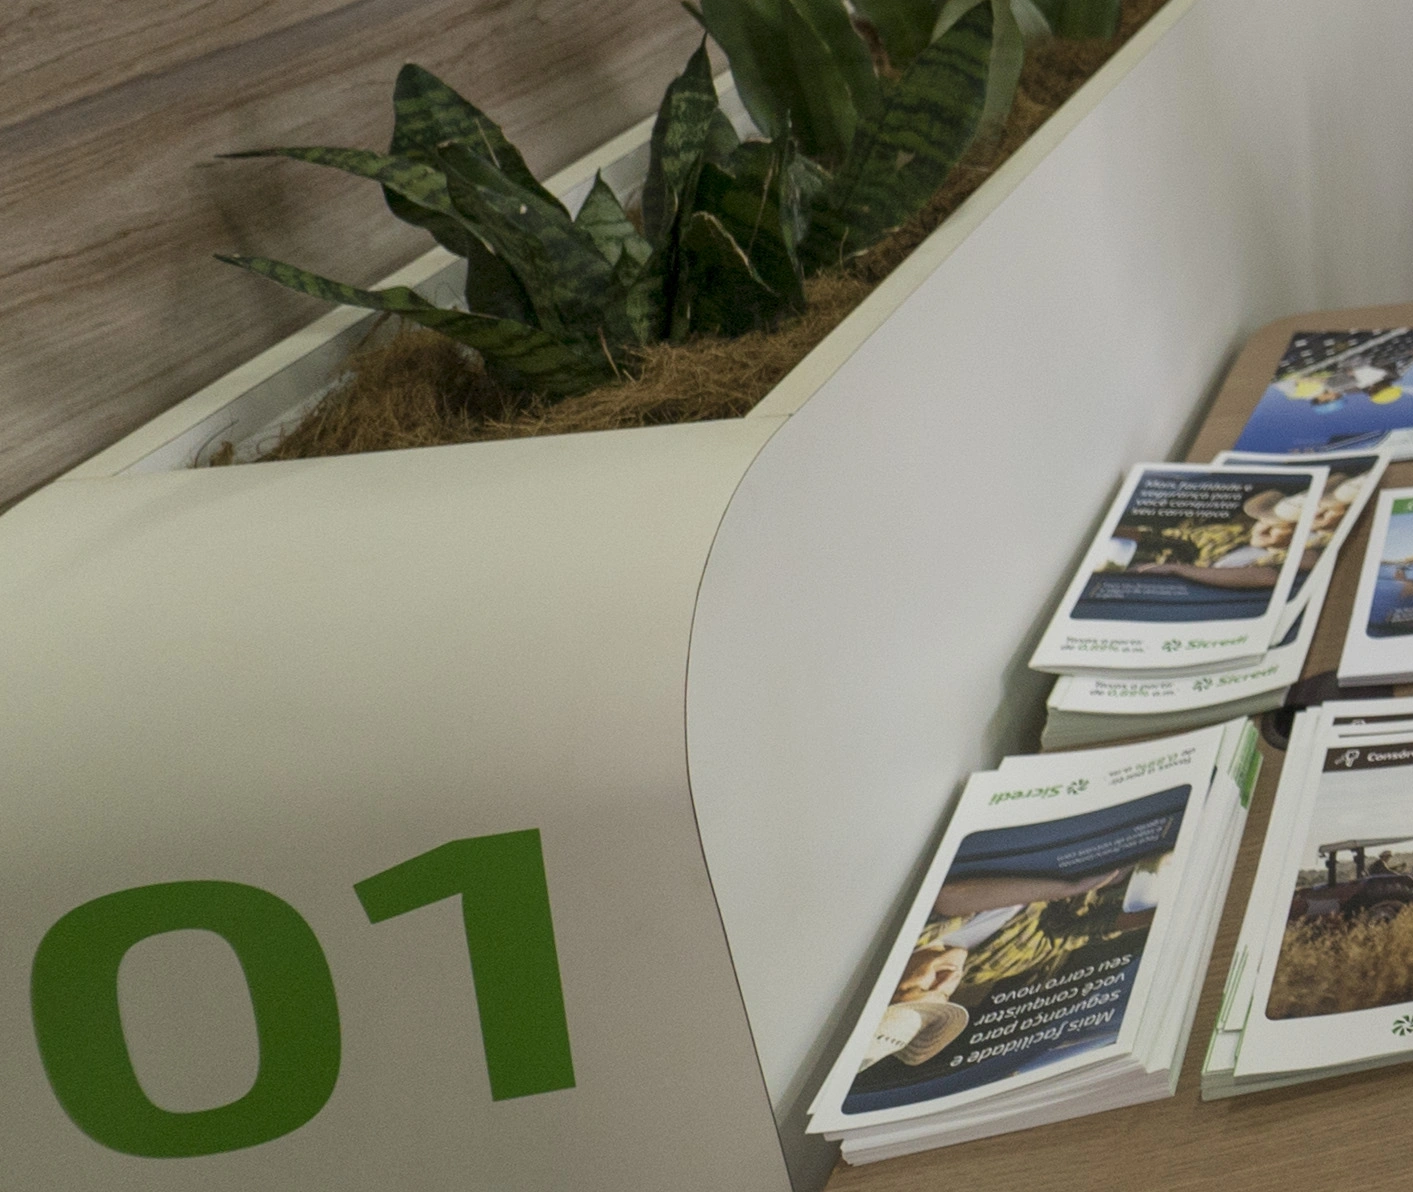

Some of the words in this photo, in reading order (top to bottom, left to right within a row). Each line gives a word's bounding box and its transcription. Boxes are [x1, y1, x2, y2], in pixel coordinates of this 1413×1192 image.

[988, 784, 1063, 806] Sicredi
[1098, 953, 1133, 973] seu
[1045, 966, 1094, 990] carro
[1081, 972, 1125, 997] você
[29, 828, 577, 1160] 01
[991, 983, 1042, 1004] novo.
[973, 986, 1078, 1027] conquistar
[1020, 990, 1122, 1030] segurança
[969, 1020, 1019, 1044] para
[1067, 1009, 1115, 1032] Mais
[967, 1021, 1069, 1063] facilidade
[949, 1054, 963, 1069] e
